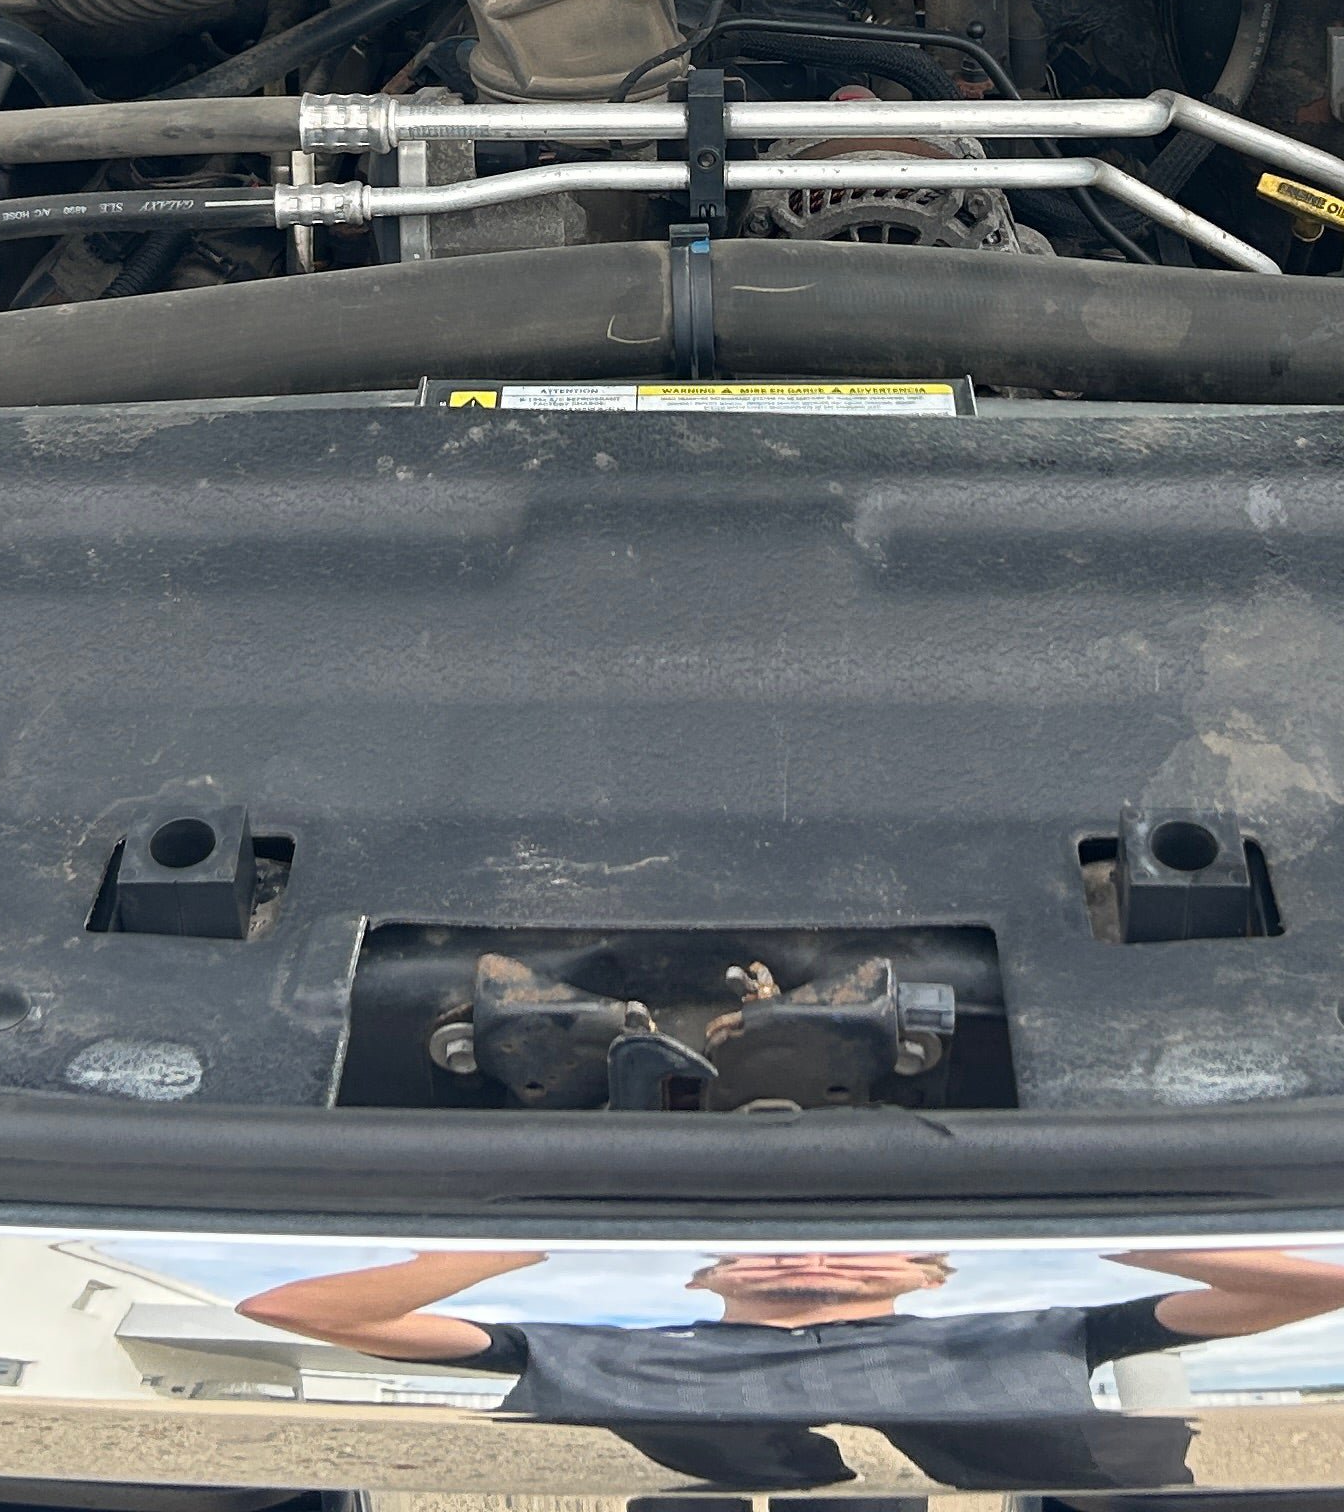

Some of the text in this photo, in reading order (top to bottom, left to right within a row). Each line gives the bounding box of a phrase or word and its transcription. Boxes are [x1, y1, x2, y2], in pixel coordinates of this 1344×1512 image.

[98, 201, 124, 214] SLE
[139, 199, 194, 212] GALAXY
[1, 210, 30, 222] HOSE
[34, 208, 52, 217] A/C
